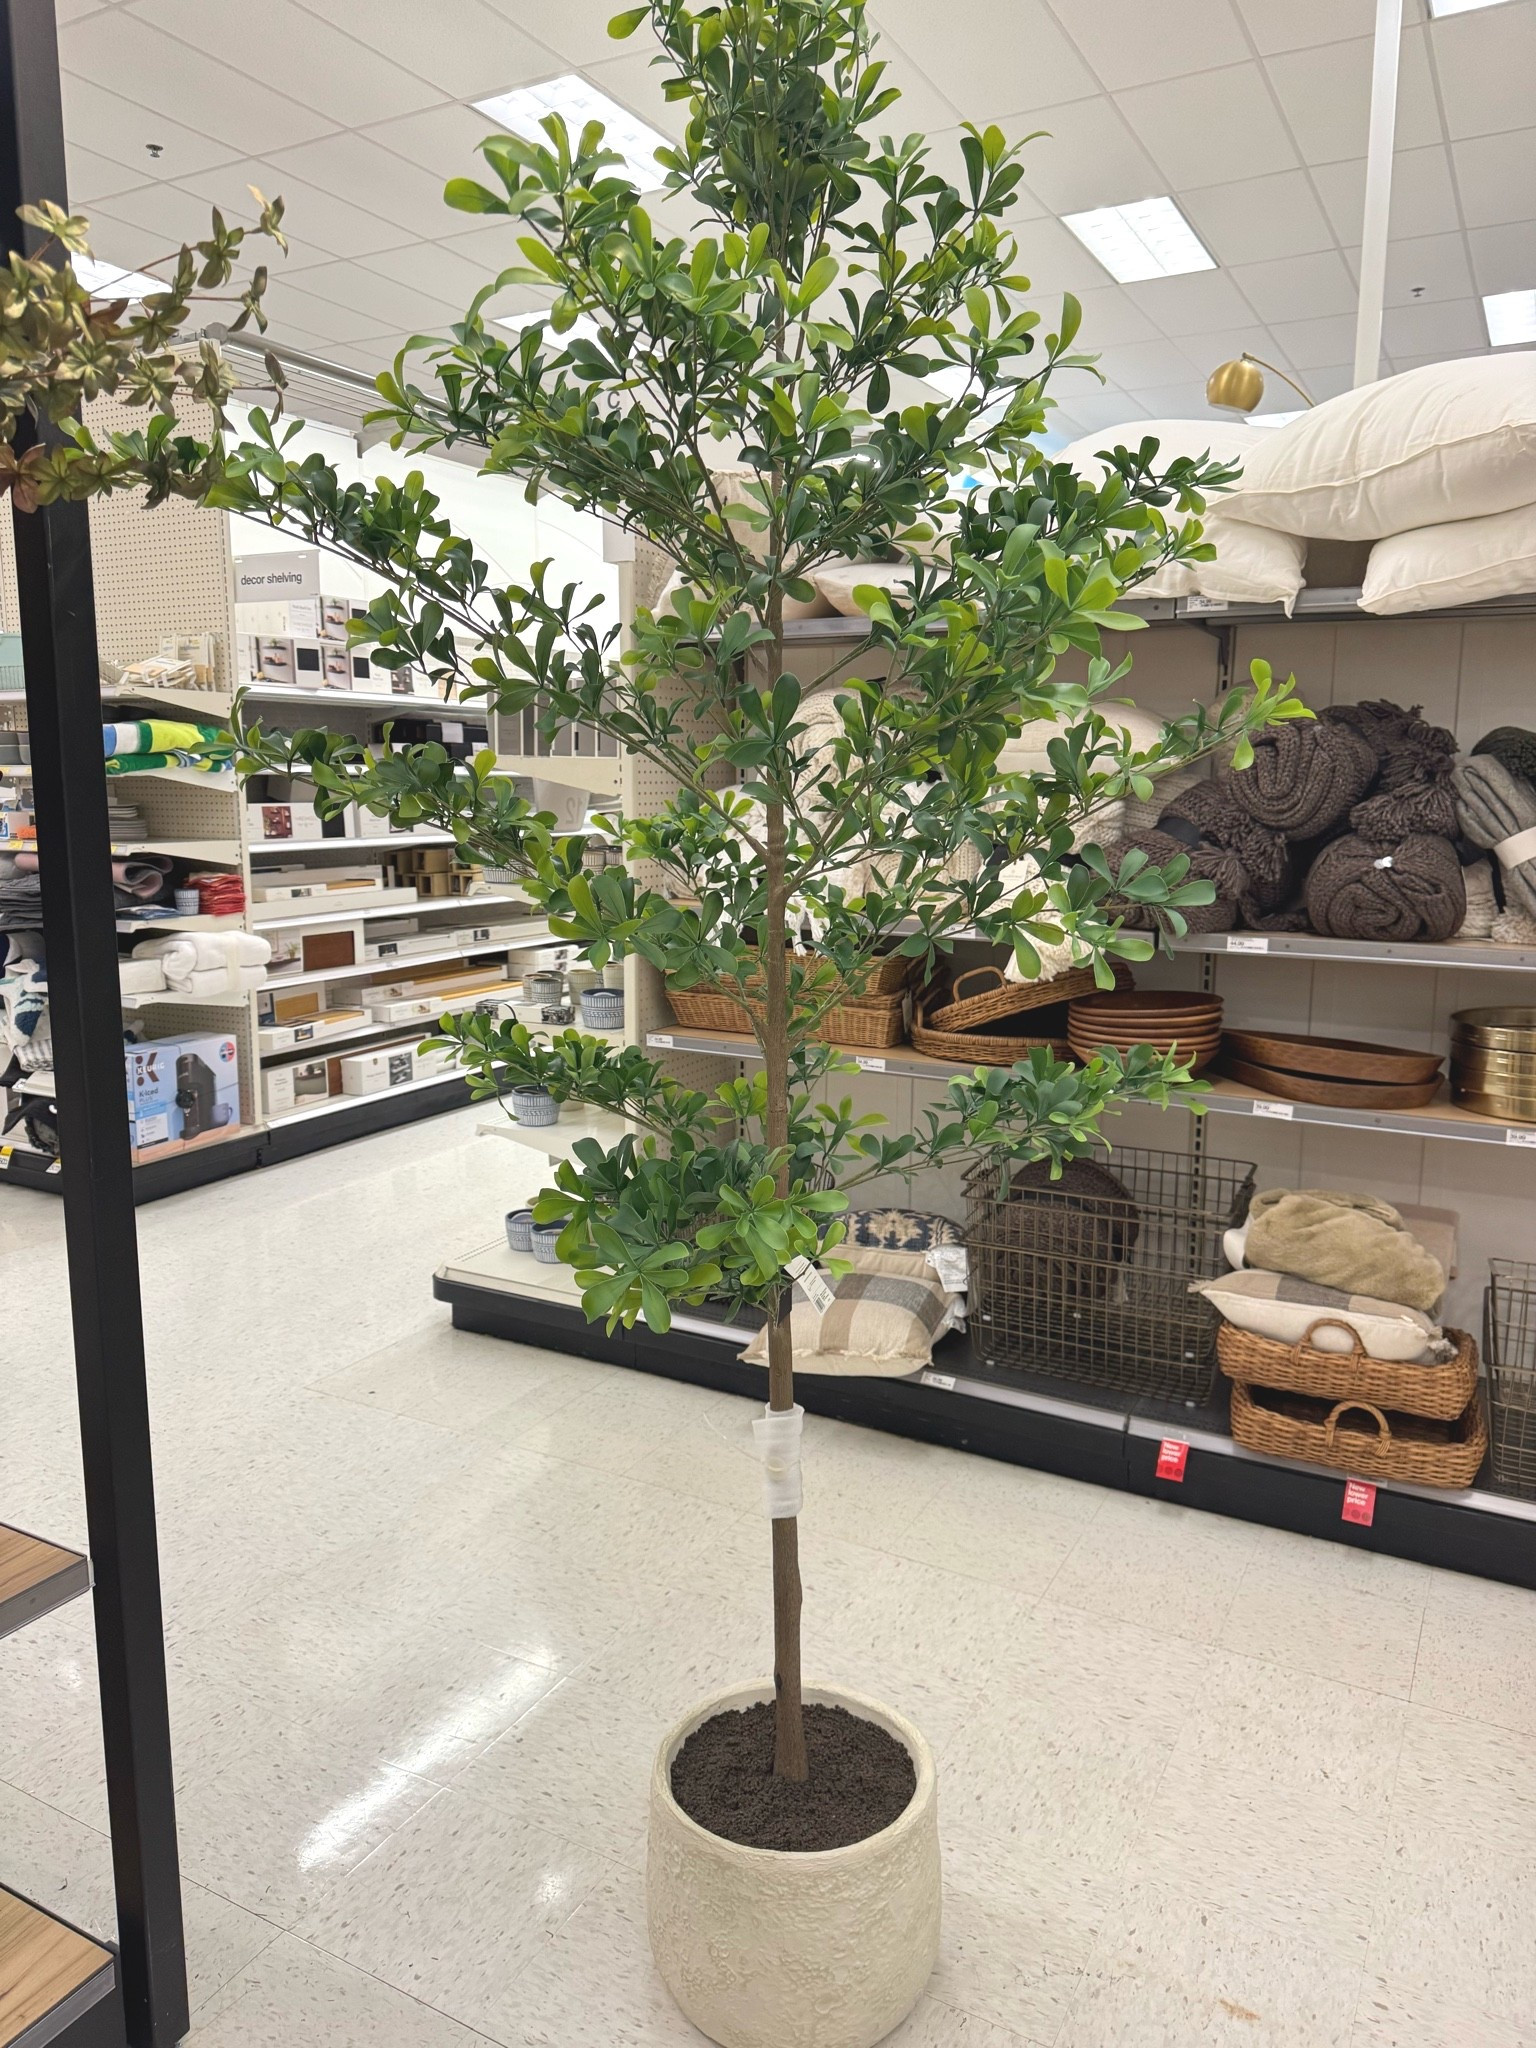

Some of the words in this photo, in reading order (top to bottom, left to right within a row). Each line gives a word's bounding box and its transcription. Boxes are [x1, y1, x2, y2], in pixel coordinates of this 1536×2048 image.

[241, 575, 265, 585] decor
[267, 572, 302, 584] shelving
[137, 1062, 165, 1074] KEURIG
[1164, 1441, 1180, 1450] New
[1162, 1448, 1181, 1457] lower
[1160, 1455, 1179, 1463] price
[1349, 1482, 1366, 1491] New
[1347, 1490, 1369, 1499] lower
[1346, 1497, 1366, 1506] price
